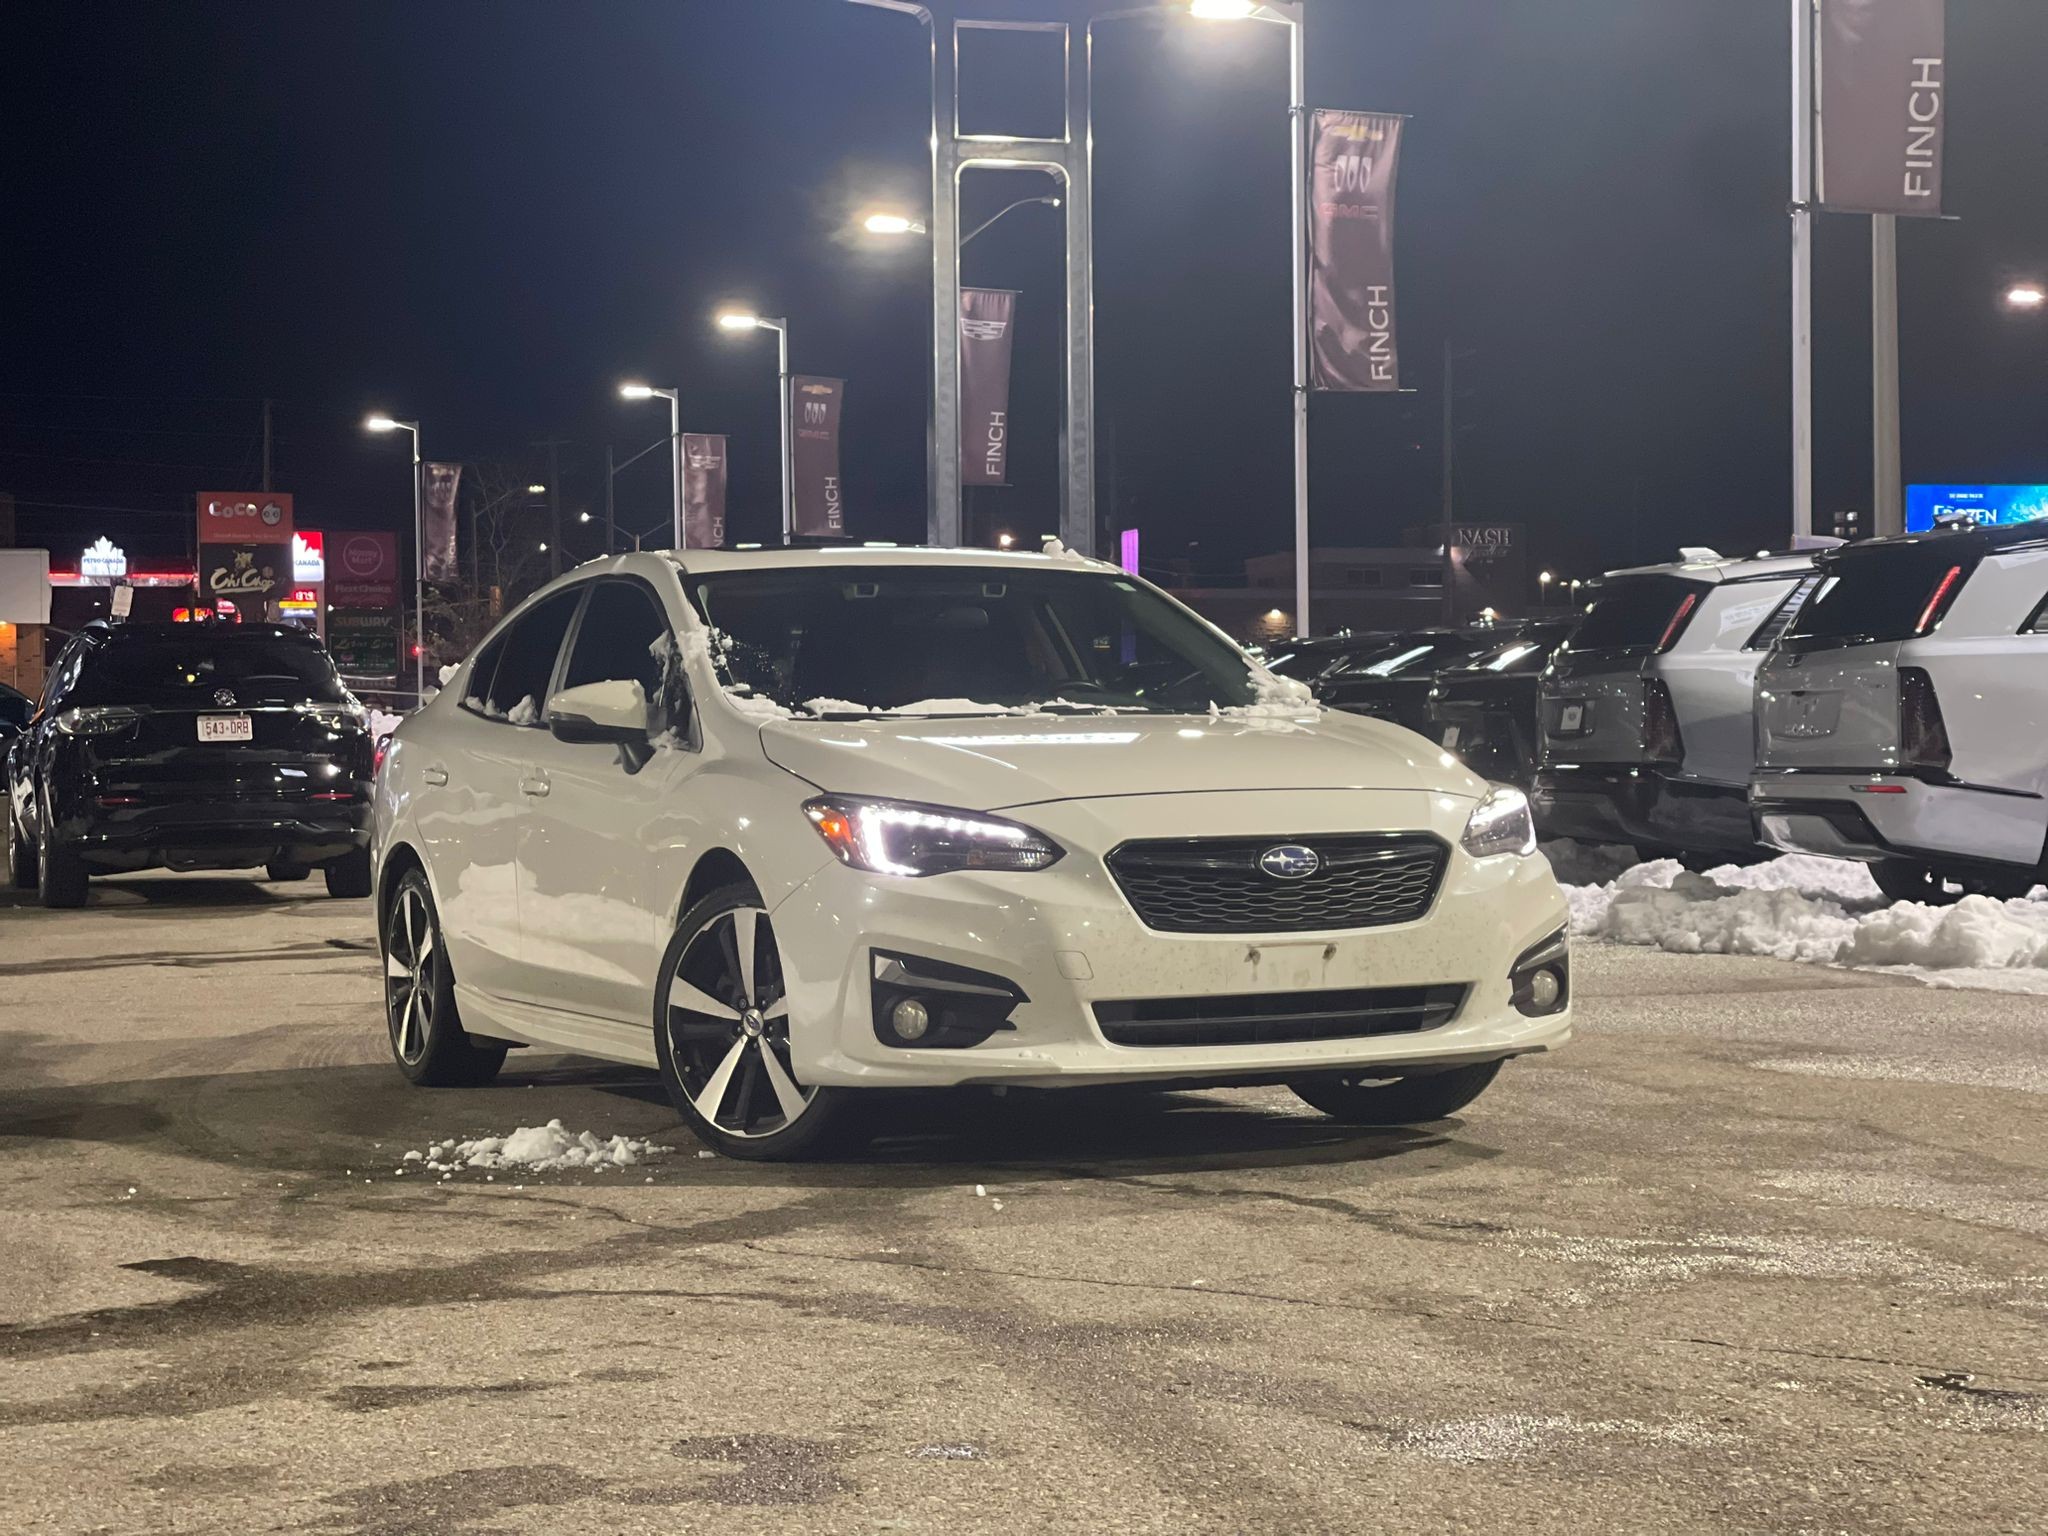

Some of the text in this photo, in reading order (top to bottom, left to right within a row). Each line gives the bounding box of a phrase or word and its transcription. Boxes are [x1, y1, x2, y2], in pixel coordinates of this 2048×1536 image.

[1903, 58, 1942, 196] FINCH
[1319, 202, 1378, 218] GMC
[1367, 285, 1392, 381] FINCH
[986, 411, 1005, 475] FINCH
[824, 477, 841, 529] FINCH
[1457, 528, 1511, 545] NASH
[334, 616, 392, 627] SUBWAY
